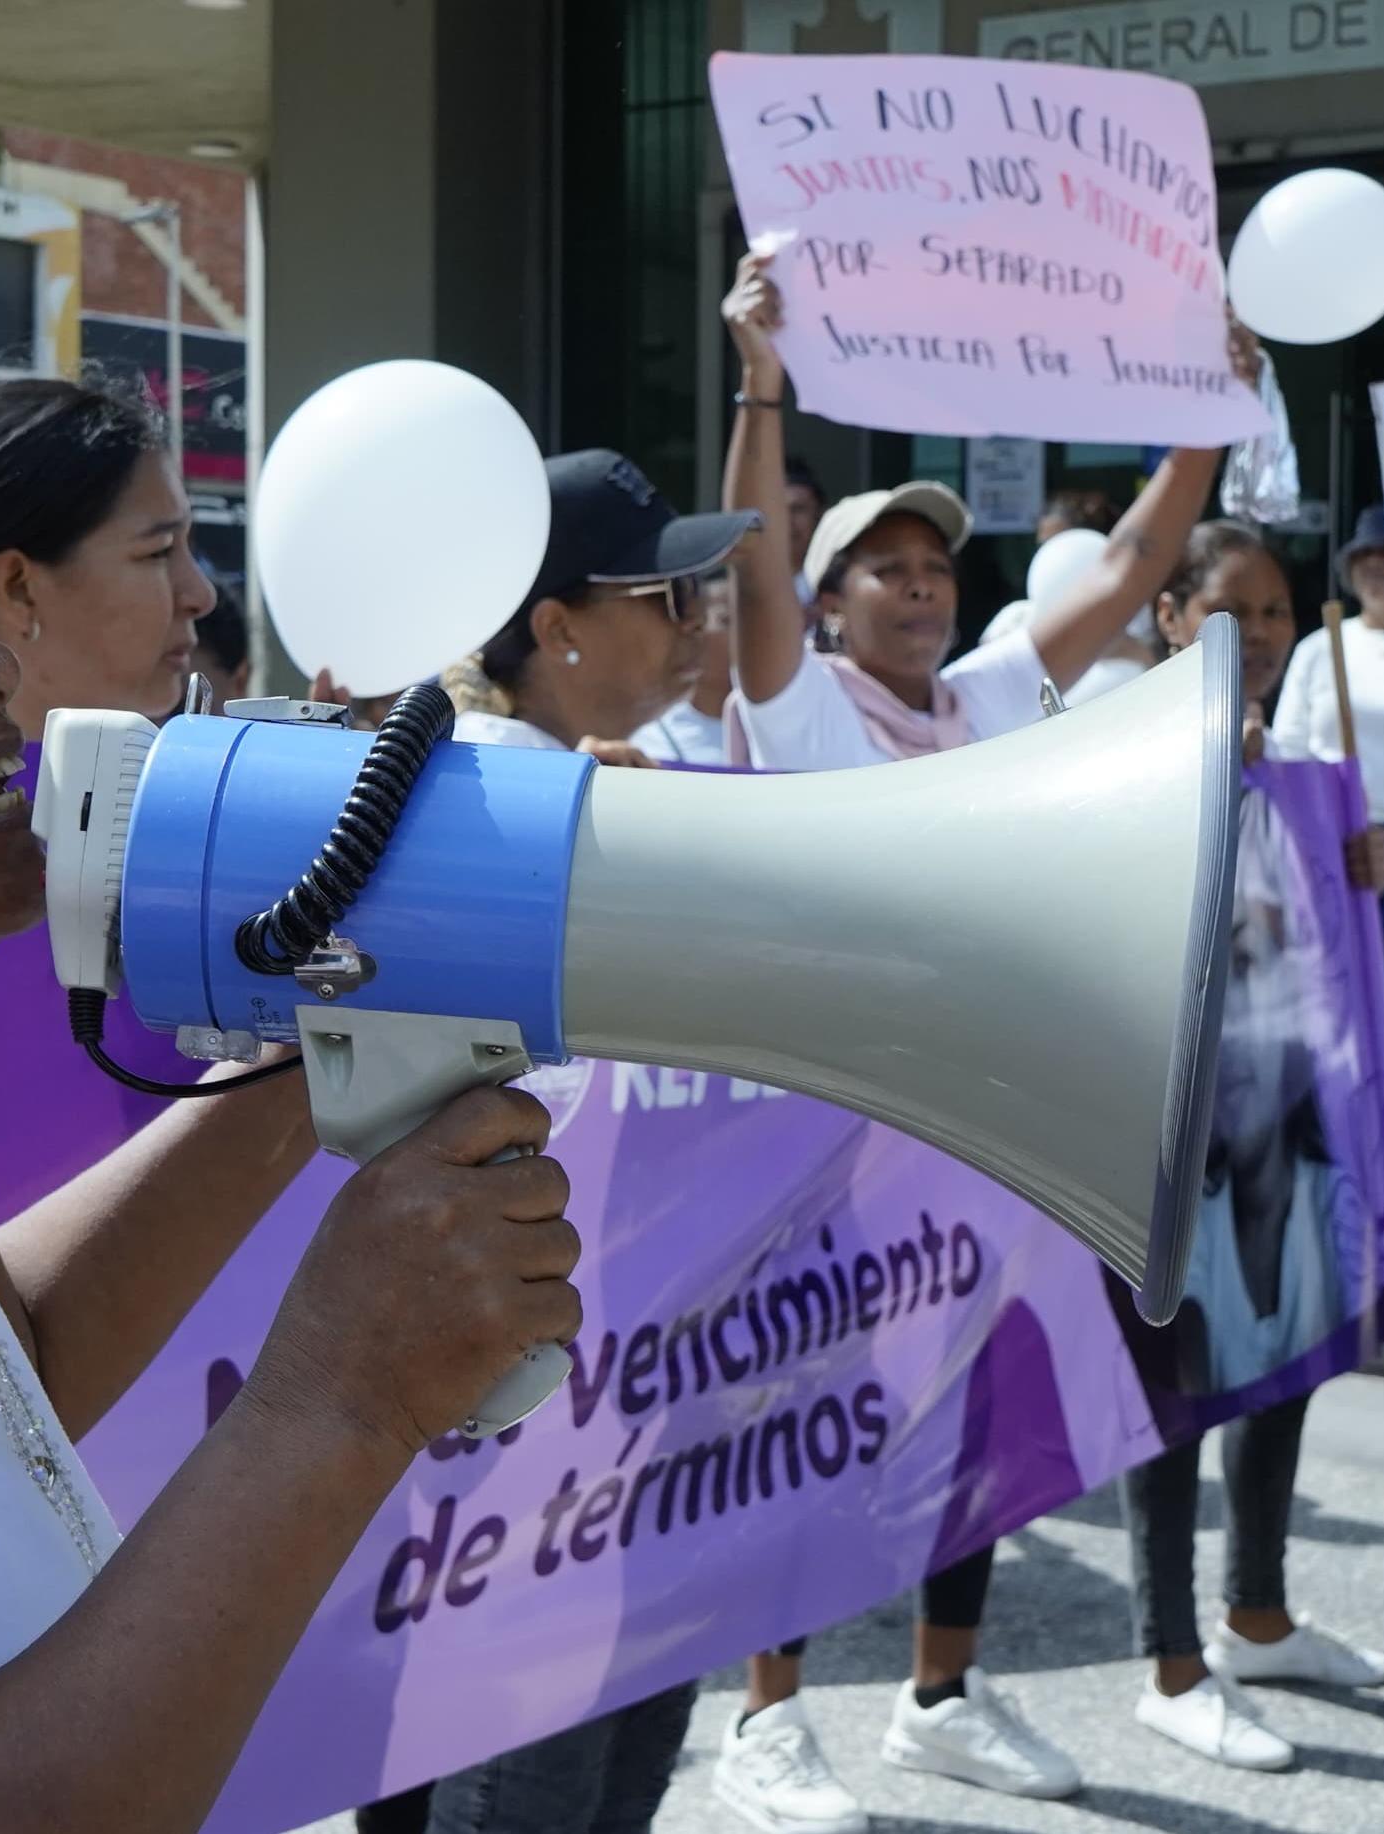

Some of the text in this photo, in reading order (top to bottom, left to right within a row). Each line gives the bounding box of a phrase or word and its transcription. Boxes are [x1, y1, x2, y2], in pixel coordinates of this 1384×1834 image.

[1289, 1, 1368, 53] DE
[760, 82, 1211, 249] SI NO LUCHAMOS
[969, 157, 1041, 205] NOS
[797, 236, 888, 289] POR
[567, 1210, 981, 1429] vencimiento
[374, 1382, 889, 1634] de términos
